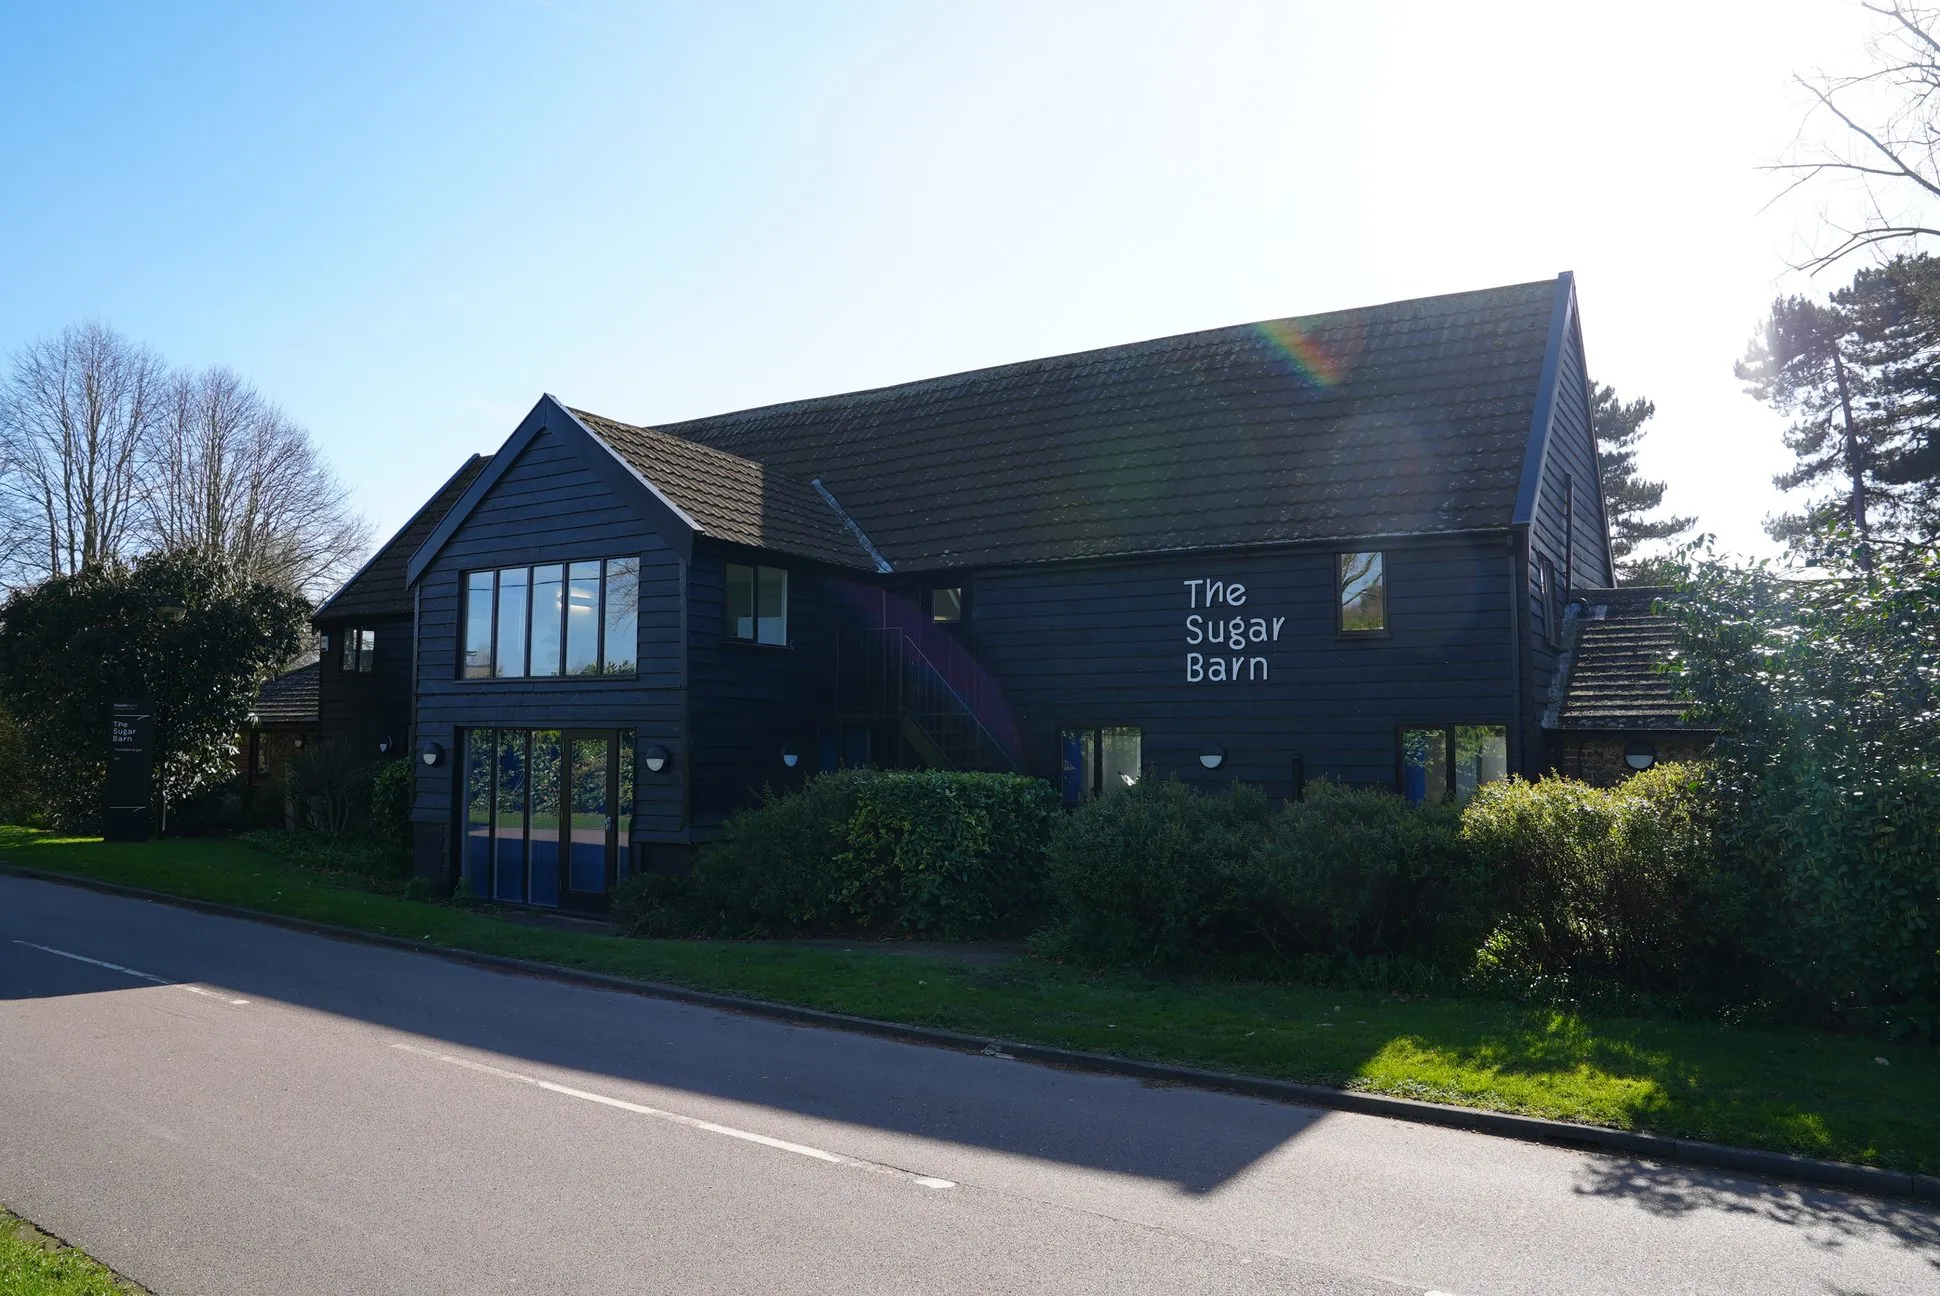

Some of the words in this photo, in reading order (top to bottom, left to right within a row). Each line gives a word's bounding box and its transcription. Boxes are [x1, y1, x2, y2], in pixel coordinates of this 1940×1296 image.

[1183, 578, 1247, 609] The
[1186, 614, 1286, 650] Sugar
[1186, 652, 1269, 682] Barn
[112, 728, 137, 736] Sugar
